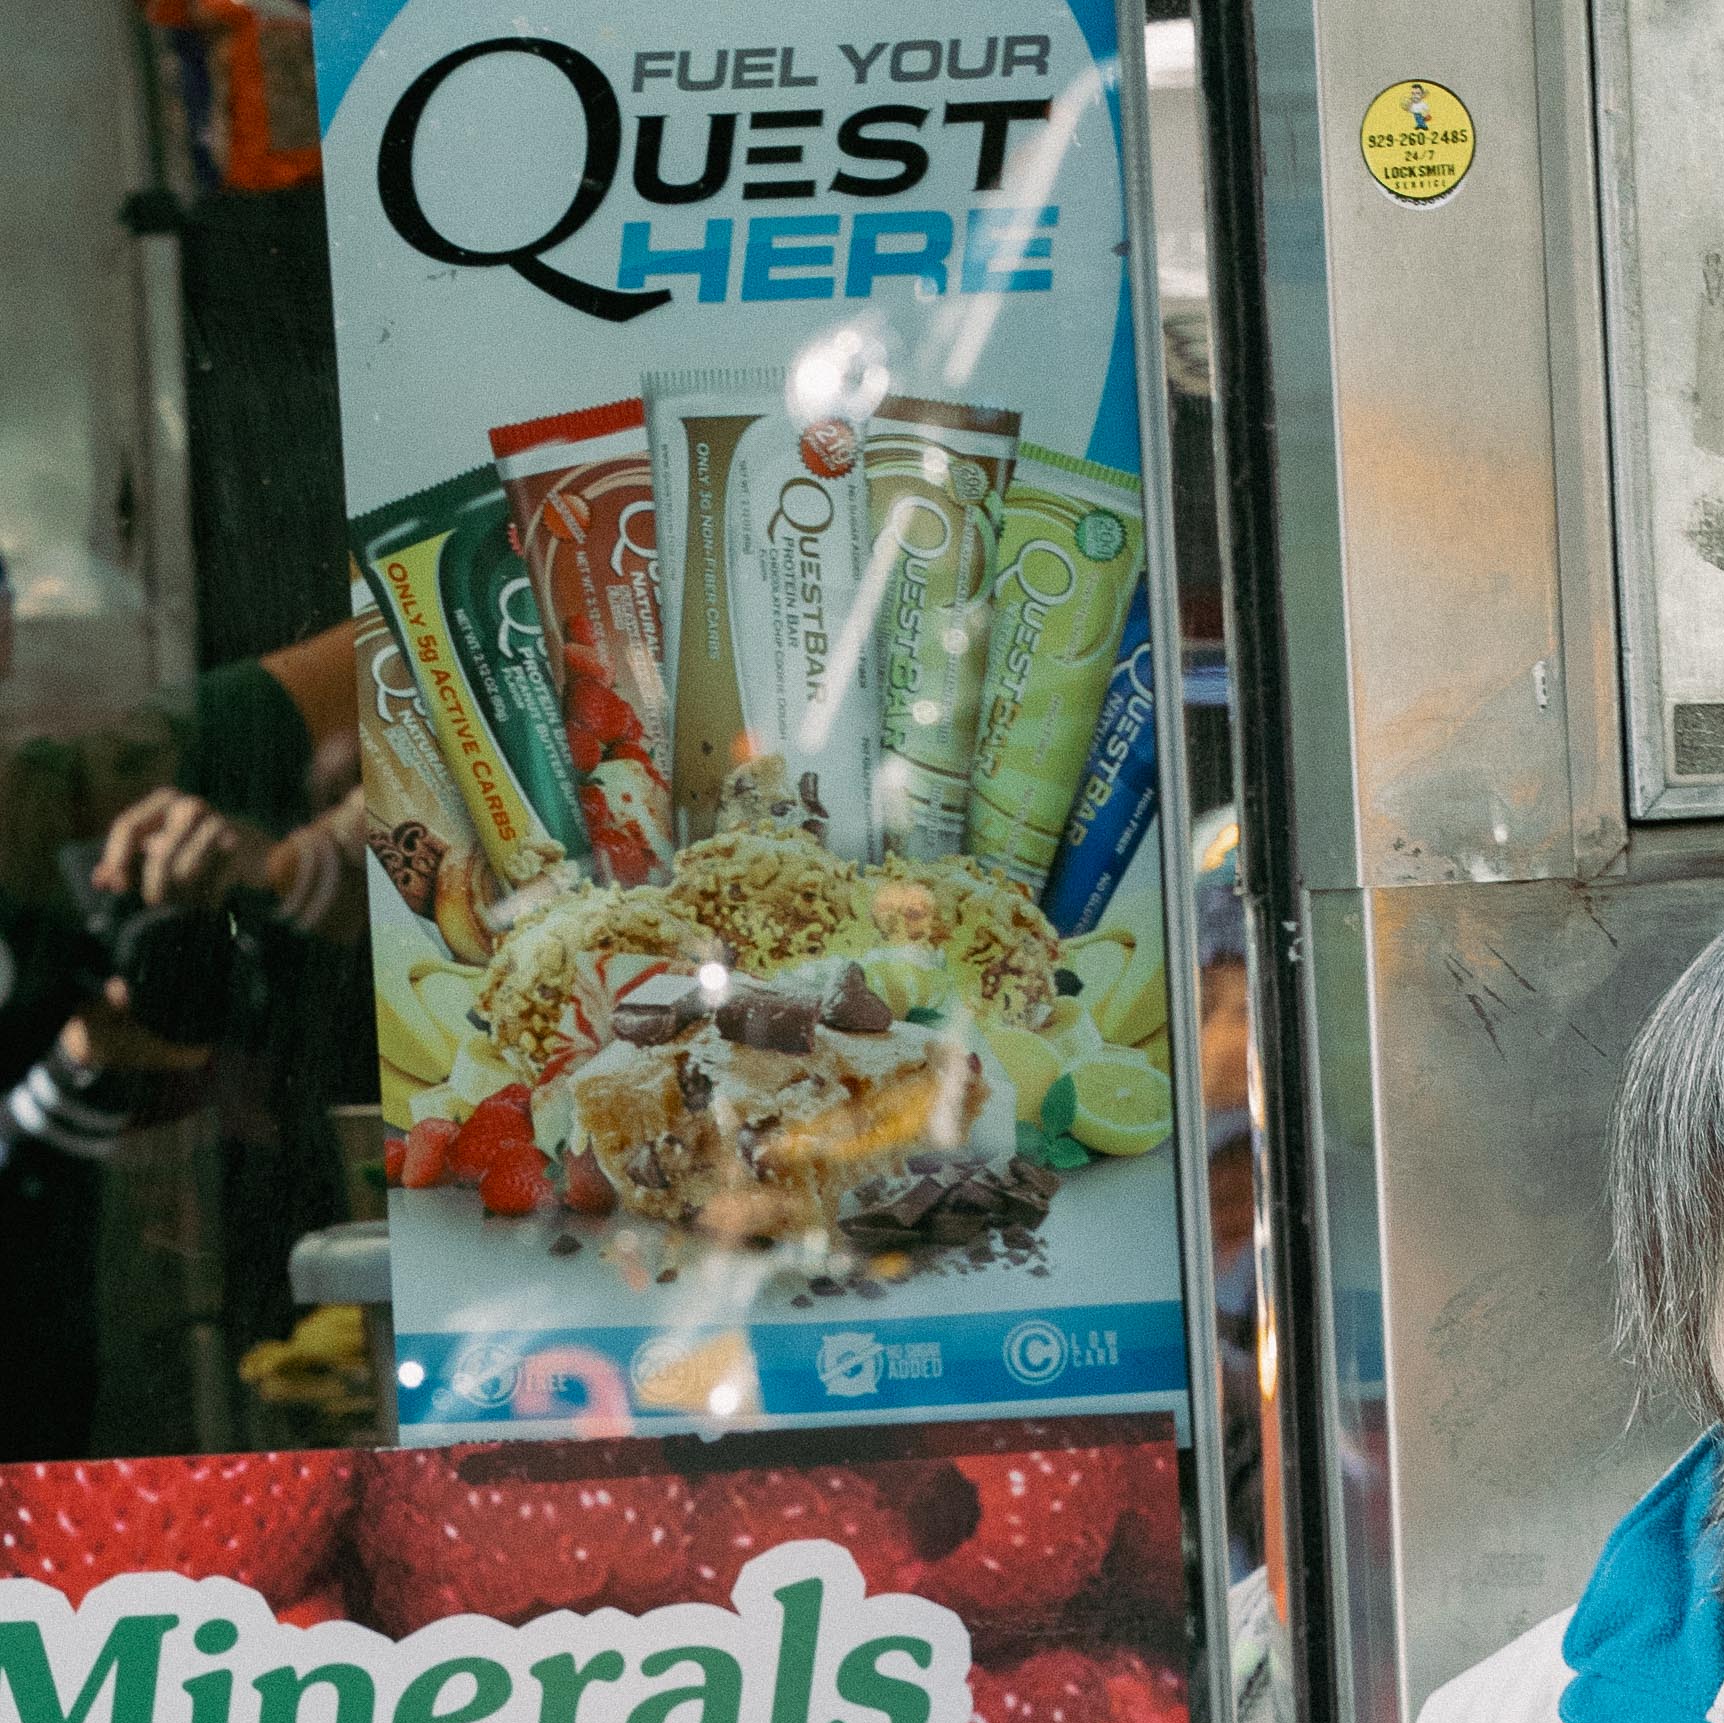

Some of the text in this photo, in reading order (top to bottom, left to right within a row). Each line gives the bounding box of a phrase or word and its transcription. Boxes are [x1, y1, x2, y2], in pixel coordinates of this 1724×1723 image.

[630, 34, 1053, 94] FUEL YOUR
[377, 36, 1055, 322] QUEST
[1384, 163, 1456, 180] LOCKSMITH
[616, 205, 1061, 305] HERE
[387, 561, 424, 628] ONLY
[416, 633, 440, 664] 5g
[430, 667, 482, 755] ACTIVE
[471, 759, 518, 844] CARBS
